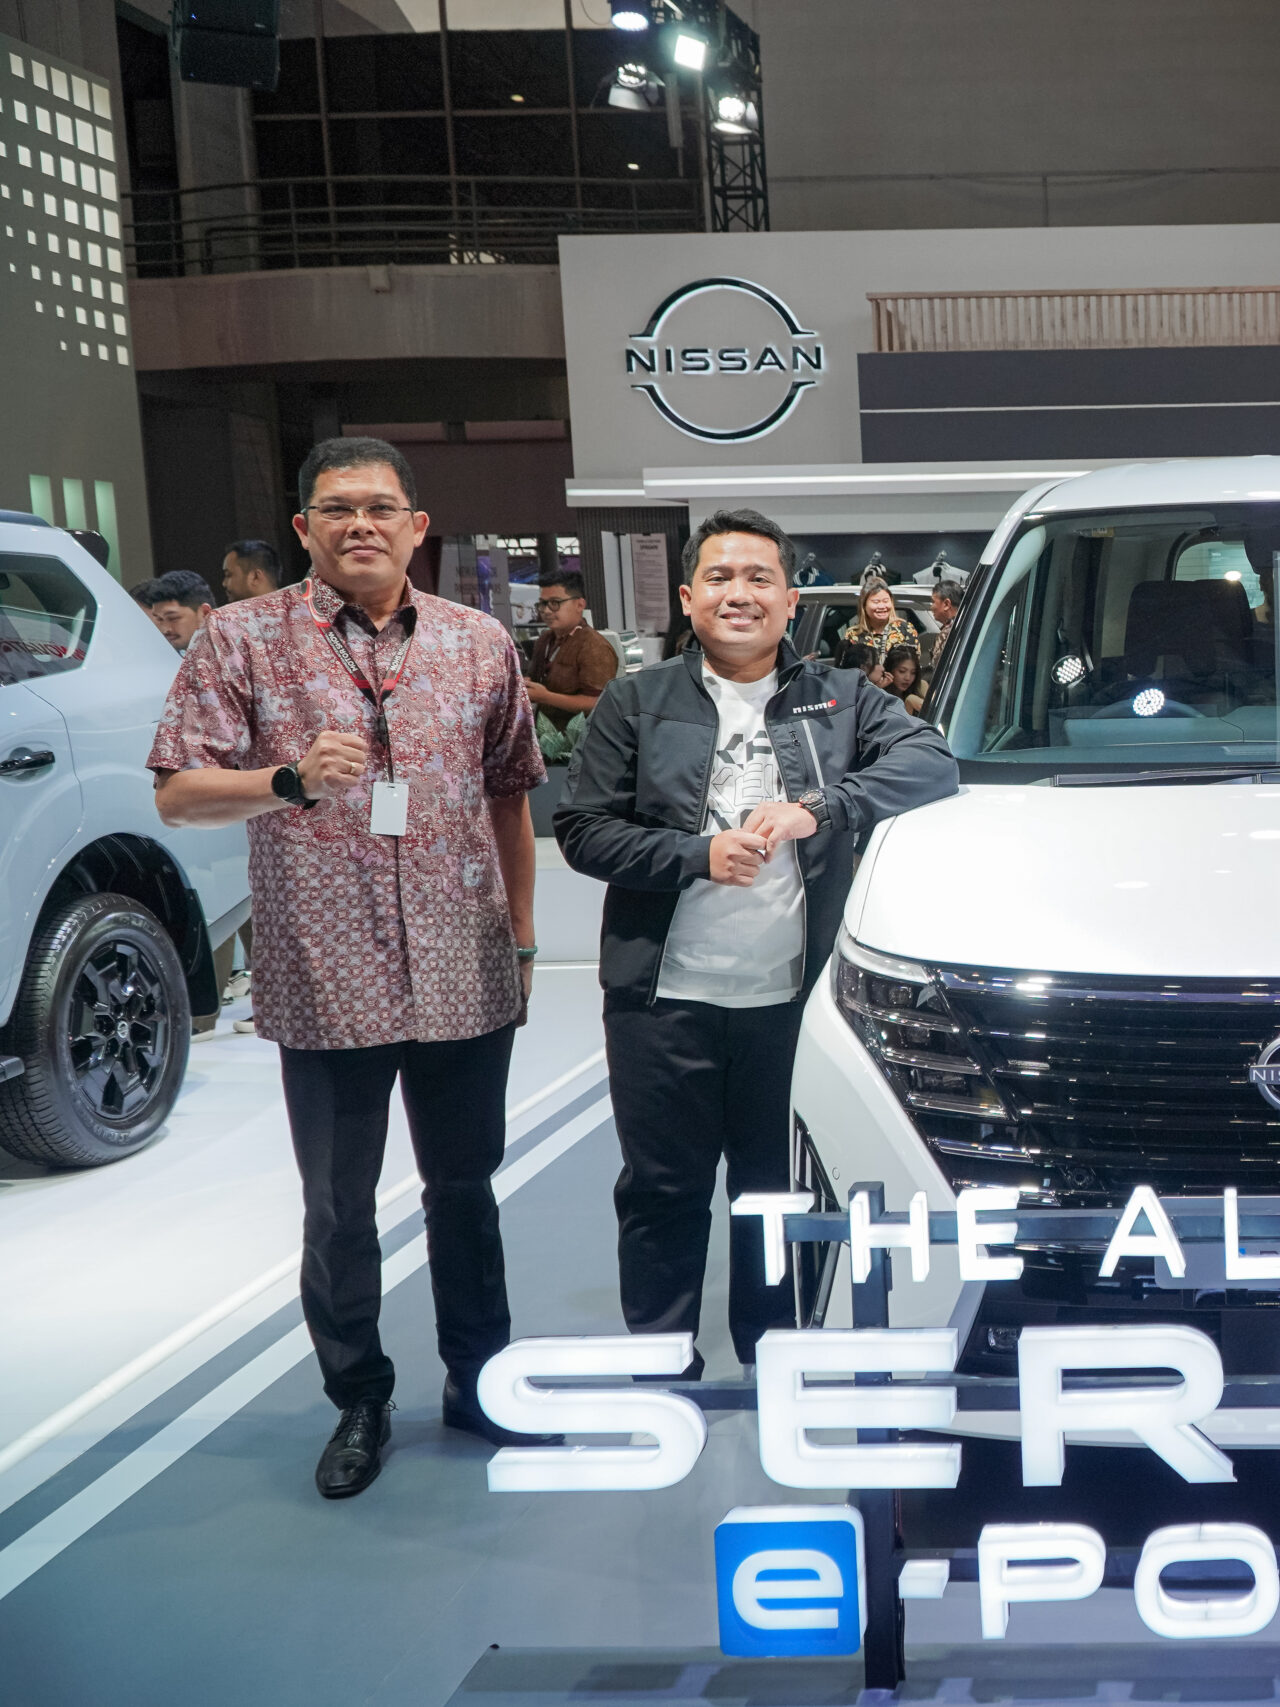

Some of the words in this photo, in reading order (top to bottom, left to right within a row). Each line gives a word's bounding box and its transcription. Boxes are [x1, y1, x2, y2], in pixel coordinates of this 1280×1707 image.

[625, 344, 824, 374] NISSAN
[340, 649, 359, 672] MOTOR
[792, 699, 837, 714] nismo
[731, 1186, 1027, 1287] THE
